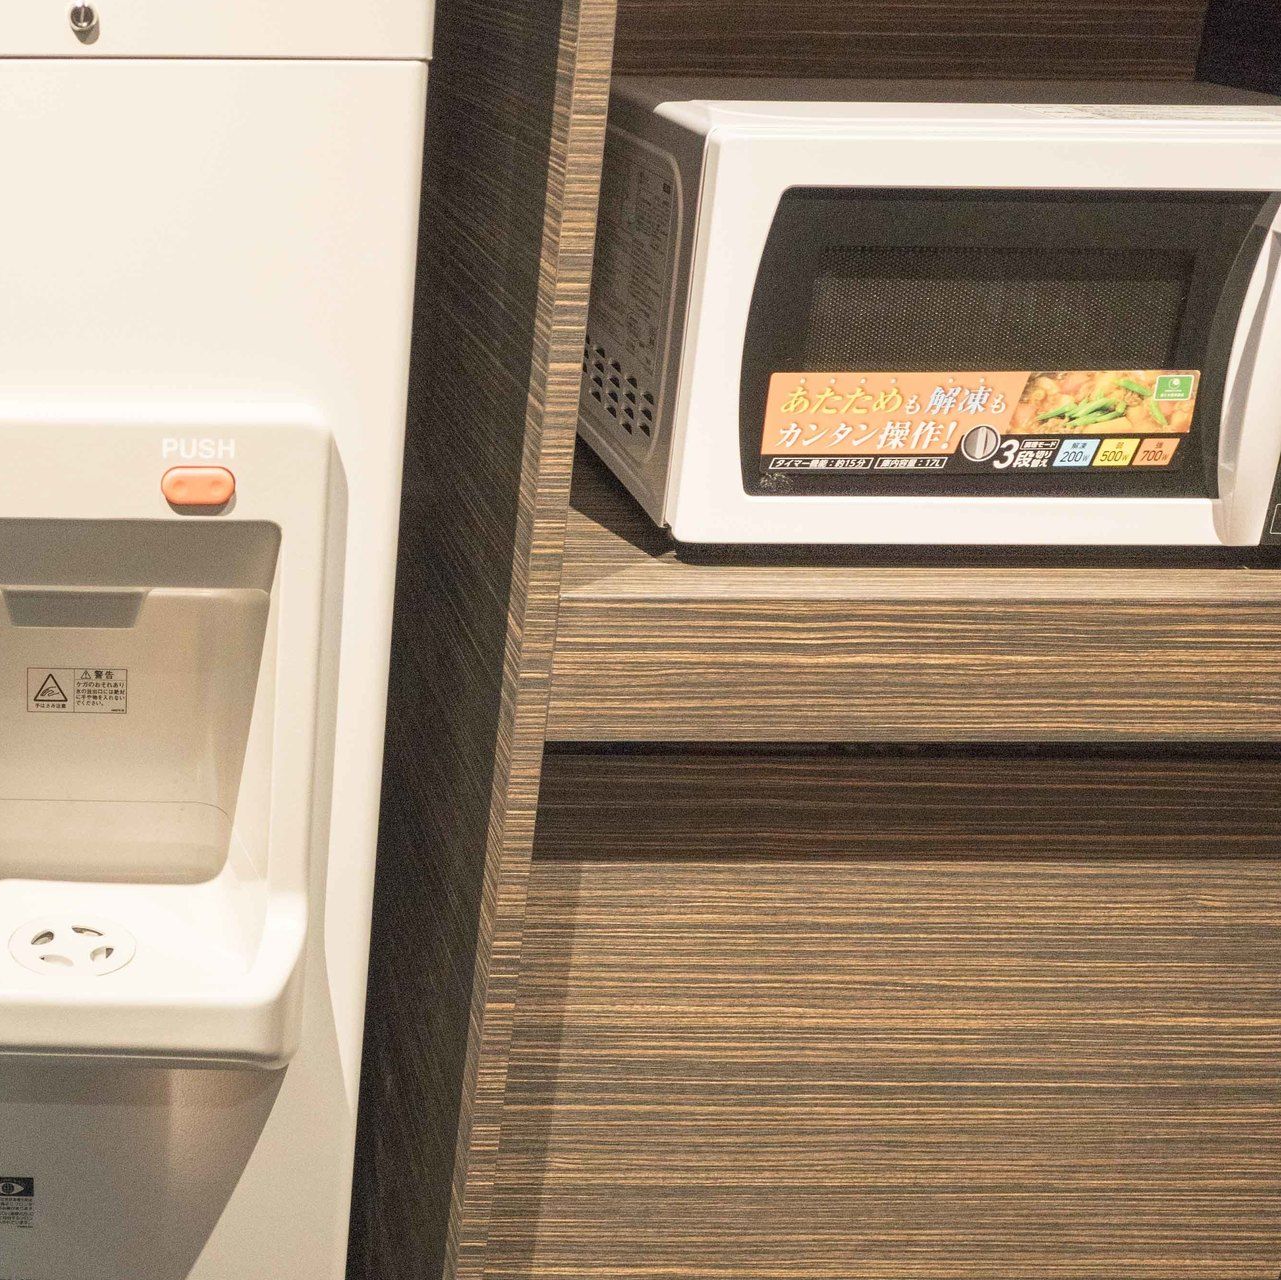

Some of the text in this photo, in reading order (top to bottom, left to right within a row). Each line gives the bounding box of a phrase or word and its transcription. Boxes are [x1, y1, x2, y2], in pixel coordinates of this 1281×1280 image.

[780, 385, 1007, 415] あたためも解凍も
[161, 438, 236, 459] PUSH
[94, 670, 114, 679] 警告
